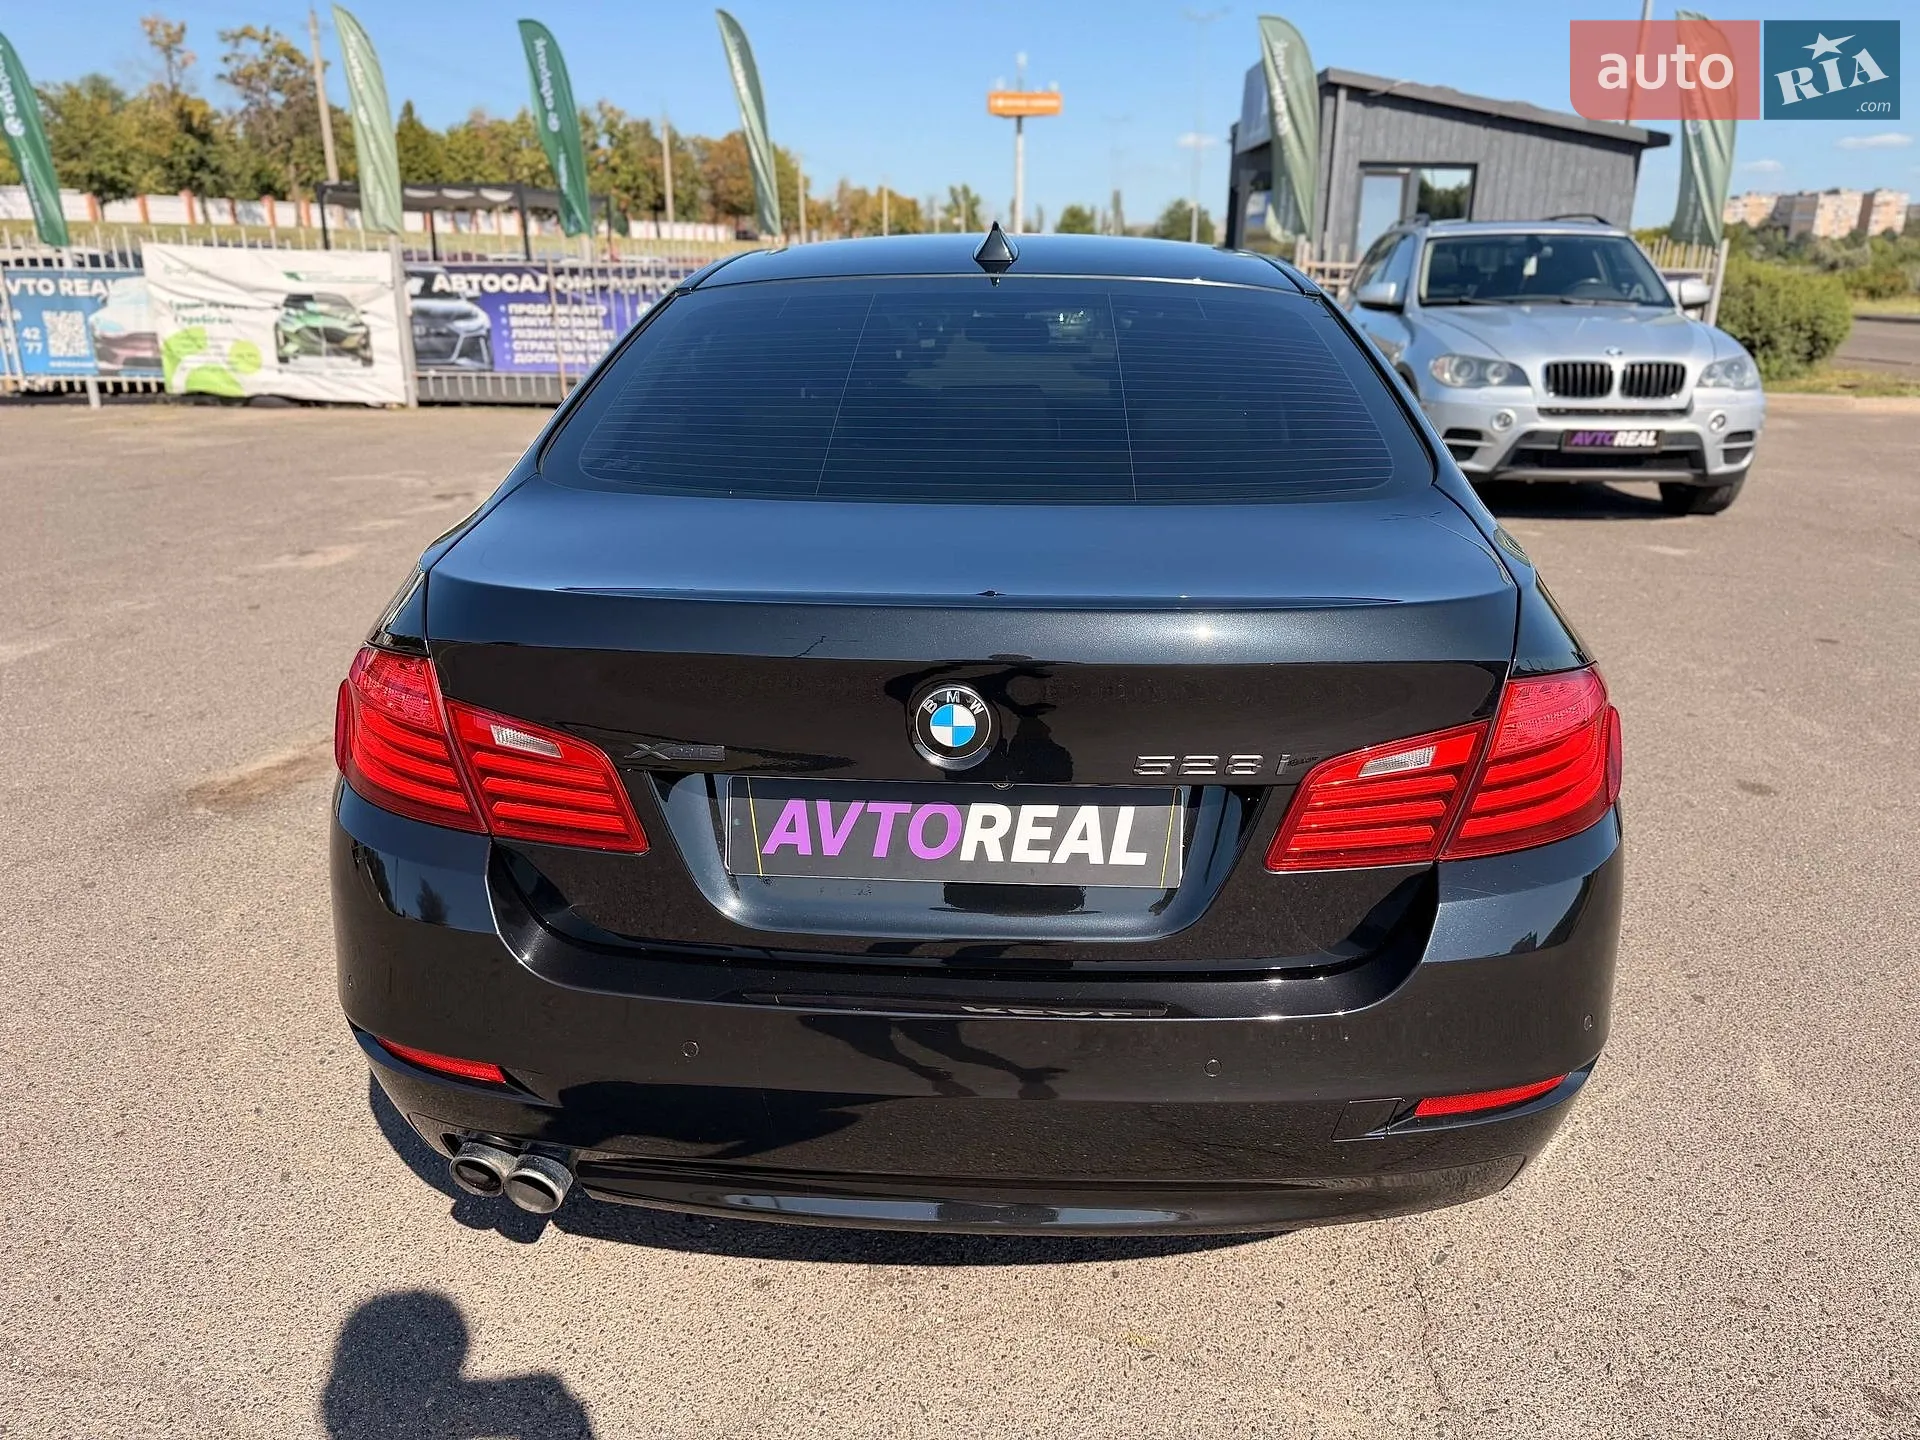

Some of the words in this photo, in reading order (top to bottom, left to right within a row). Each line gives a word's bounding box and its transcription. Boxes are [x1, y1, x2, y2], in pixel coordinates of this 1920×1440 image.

[5, 278, 56, 296] VTO
[24, 341, 43, 354] 77
[1571, 430, 1657, 447] AVTOREAL
[922, 690, 985, 715] BMW
[761, 798, 1149, 866] AVTOREAL
